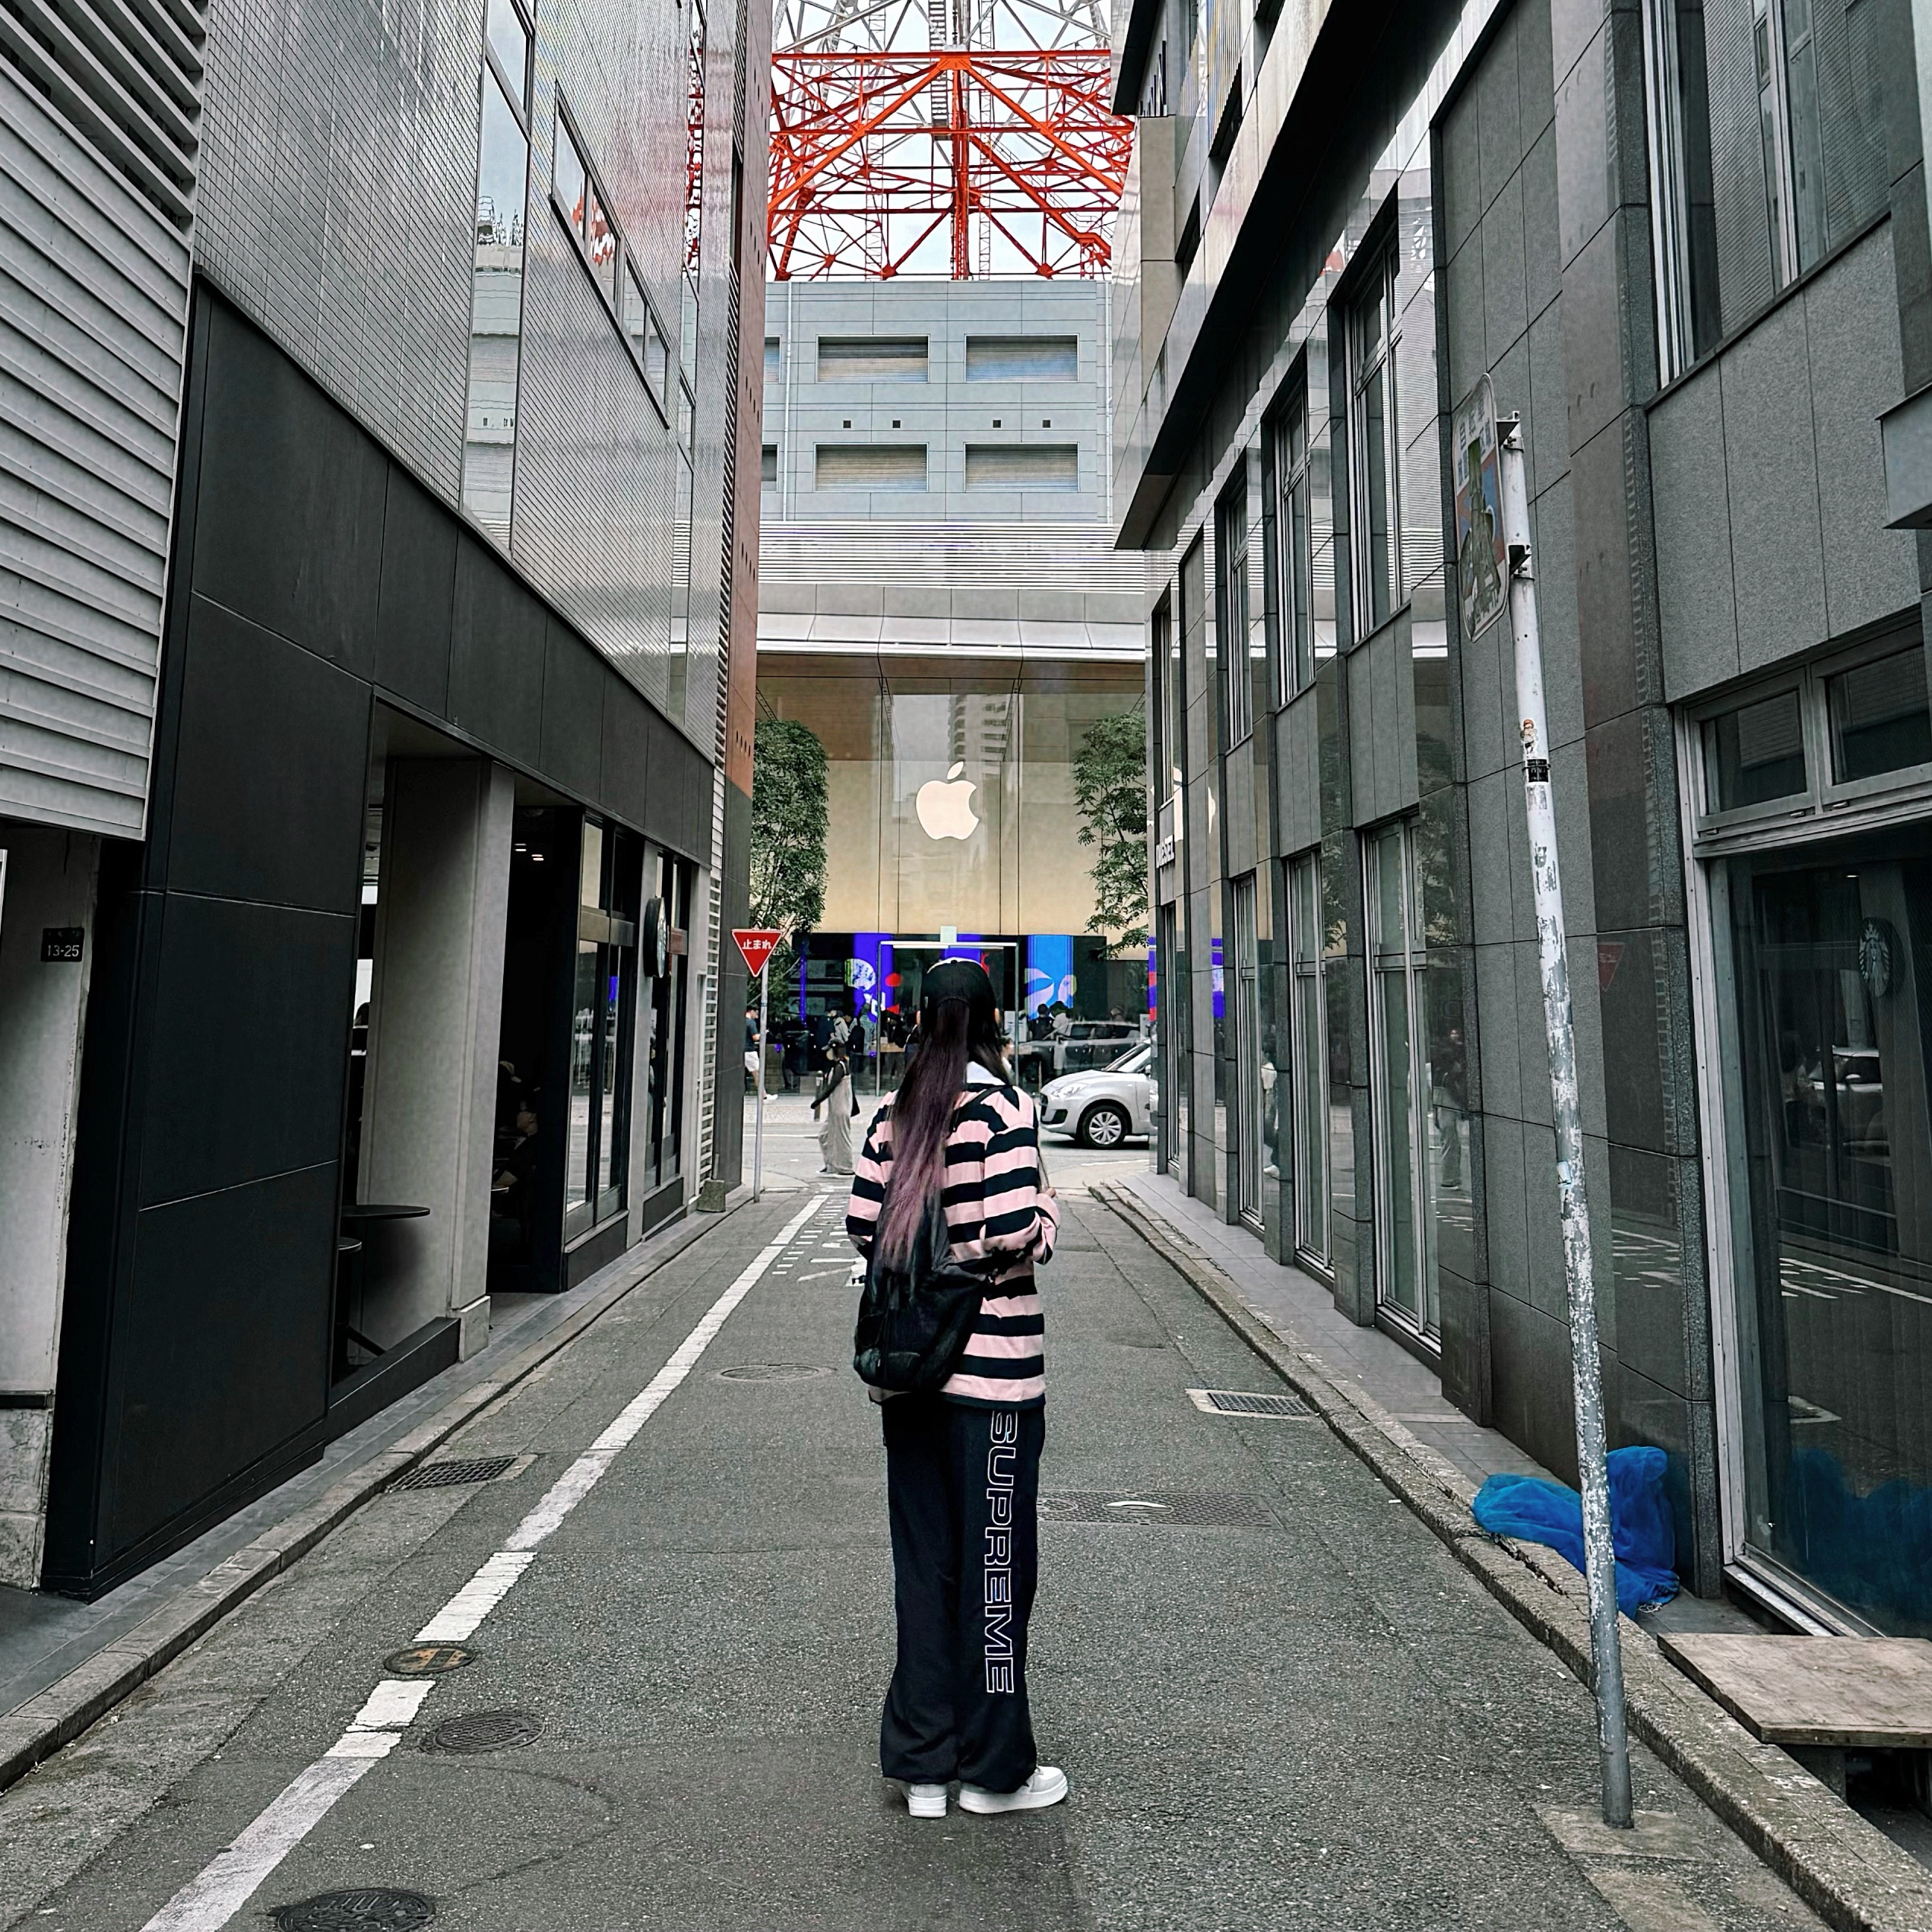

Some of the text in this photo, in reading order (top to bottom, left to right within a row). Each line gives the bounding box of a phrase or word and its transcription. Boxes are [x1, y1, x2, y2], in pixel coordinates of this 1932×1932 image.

[742, 939, 772, 950] 止まれ
[48, 945, 80, 957] 13-25
[984, 1410, 1018, 1694] SUPREME
